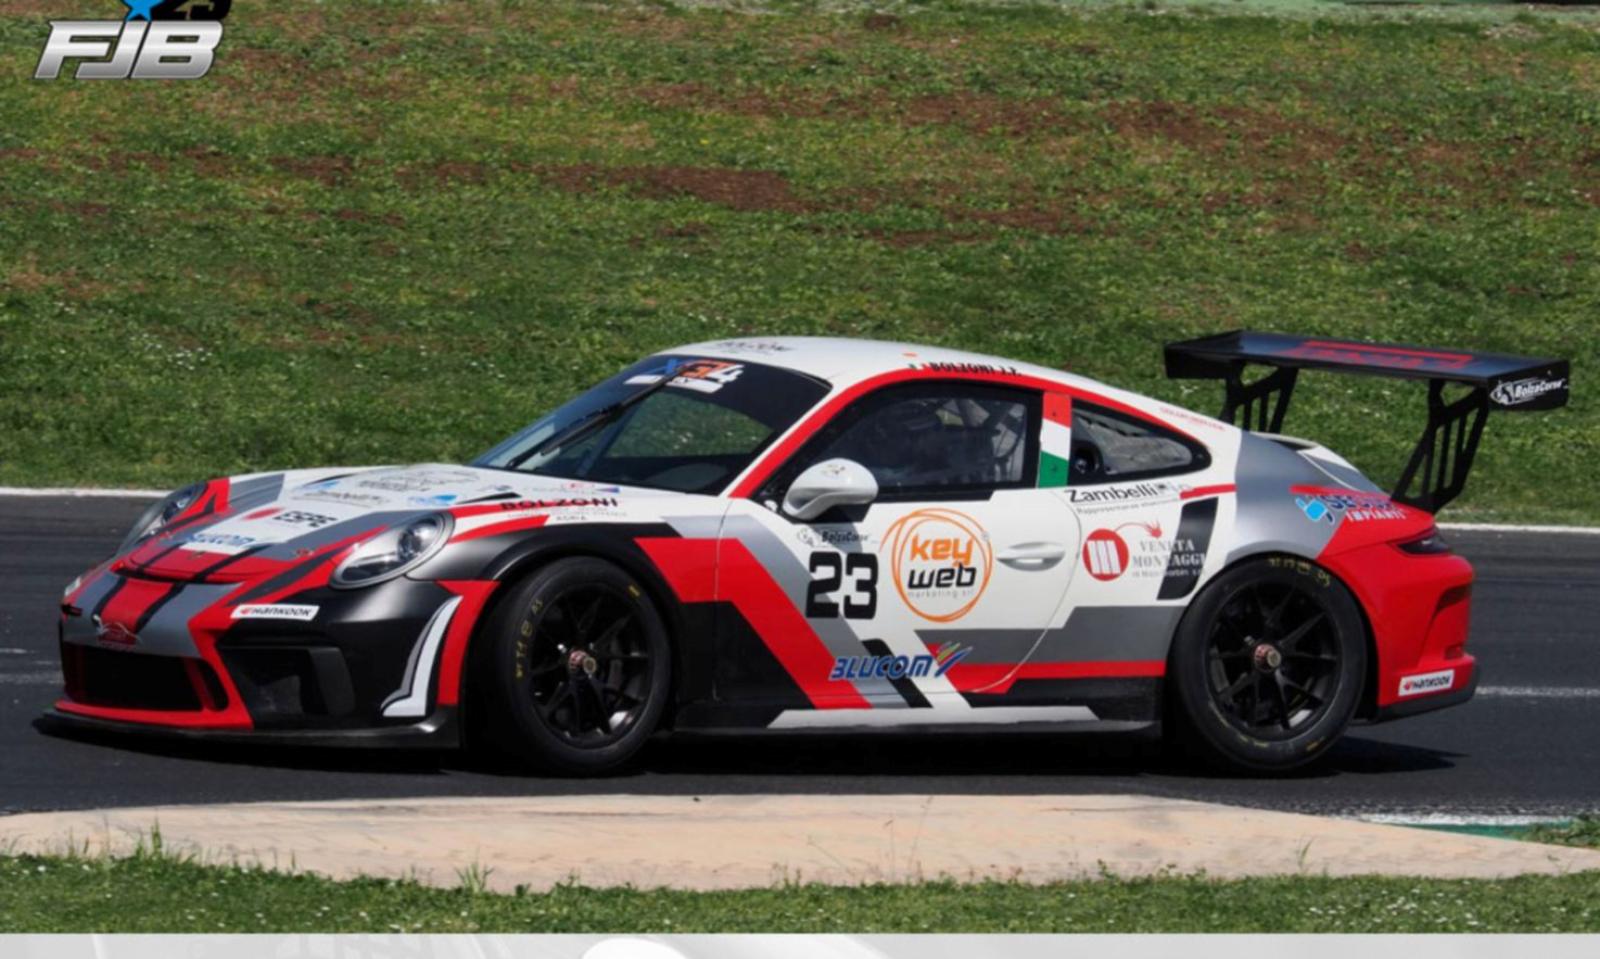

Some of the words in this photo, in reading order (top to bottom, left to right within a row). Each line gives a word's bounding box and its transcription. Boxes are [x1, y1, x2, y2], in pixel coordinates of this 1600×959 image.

[500, 497, 618, 510] BOLZONI
[1064, 483, 1159, 503] Zambelli
[909, 535, 974, 567] key
[1140, 539, 1195, 553] VENETA
[805, 551, 879, 620] 23
[907, 561, 977, 590] web
